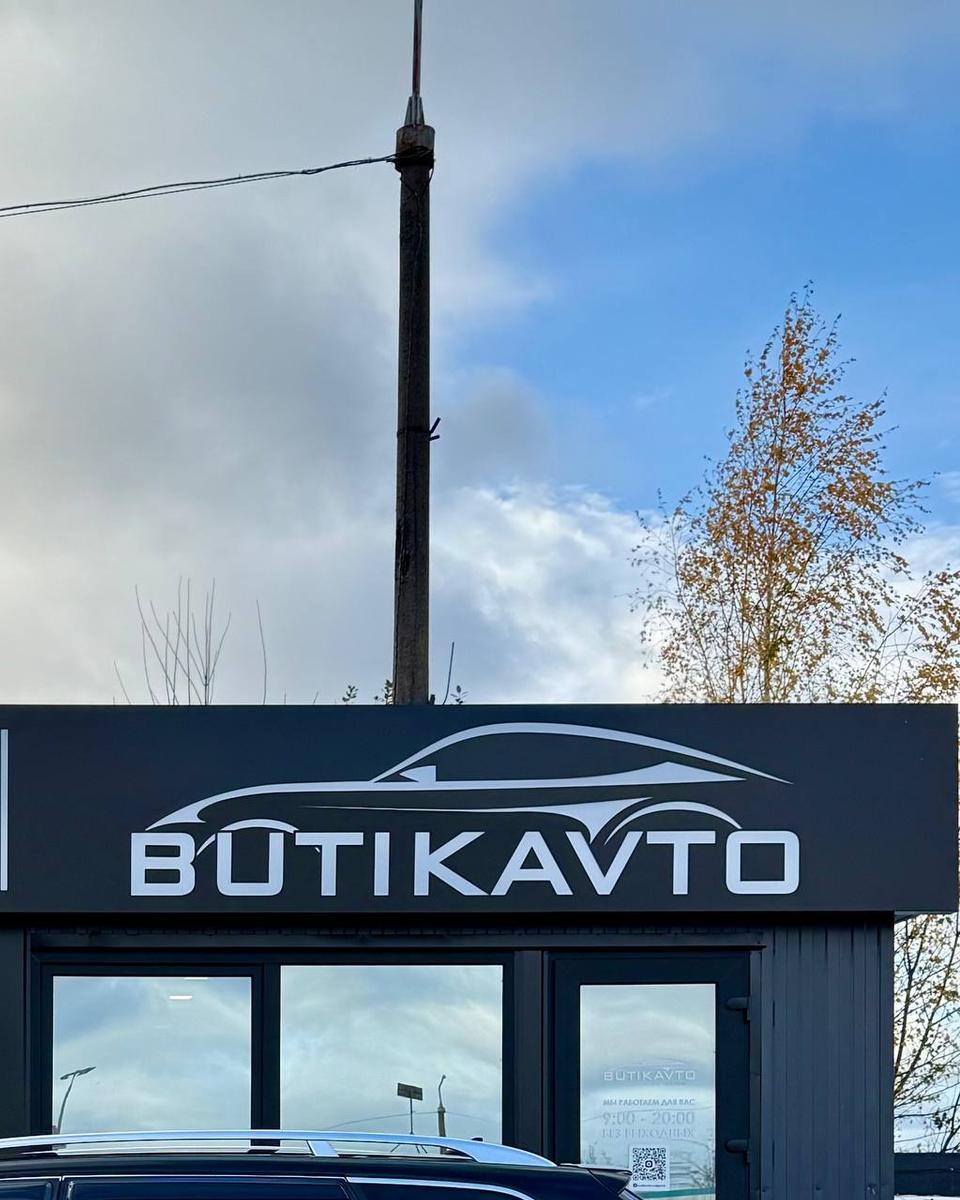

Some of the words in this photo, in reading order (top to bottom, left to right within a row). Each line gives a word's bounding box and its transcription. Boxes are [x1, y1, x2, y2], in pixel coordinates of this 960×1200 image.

[130, 830, 800, 896] BUTIKAVTO
[603, 1070, 696, 1081] BUTIKAVTO
[602, 1111, 636, 1125] 9:00
[651, 1111, 696, 1125] 20:00
